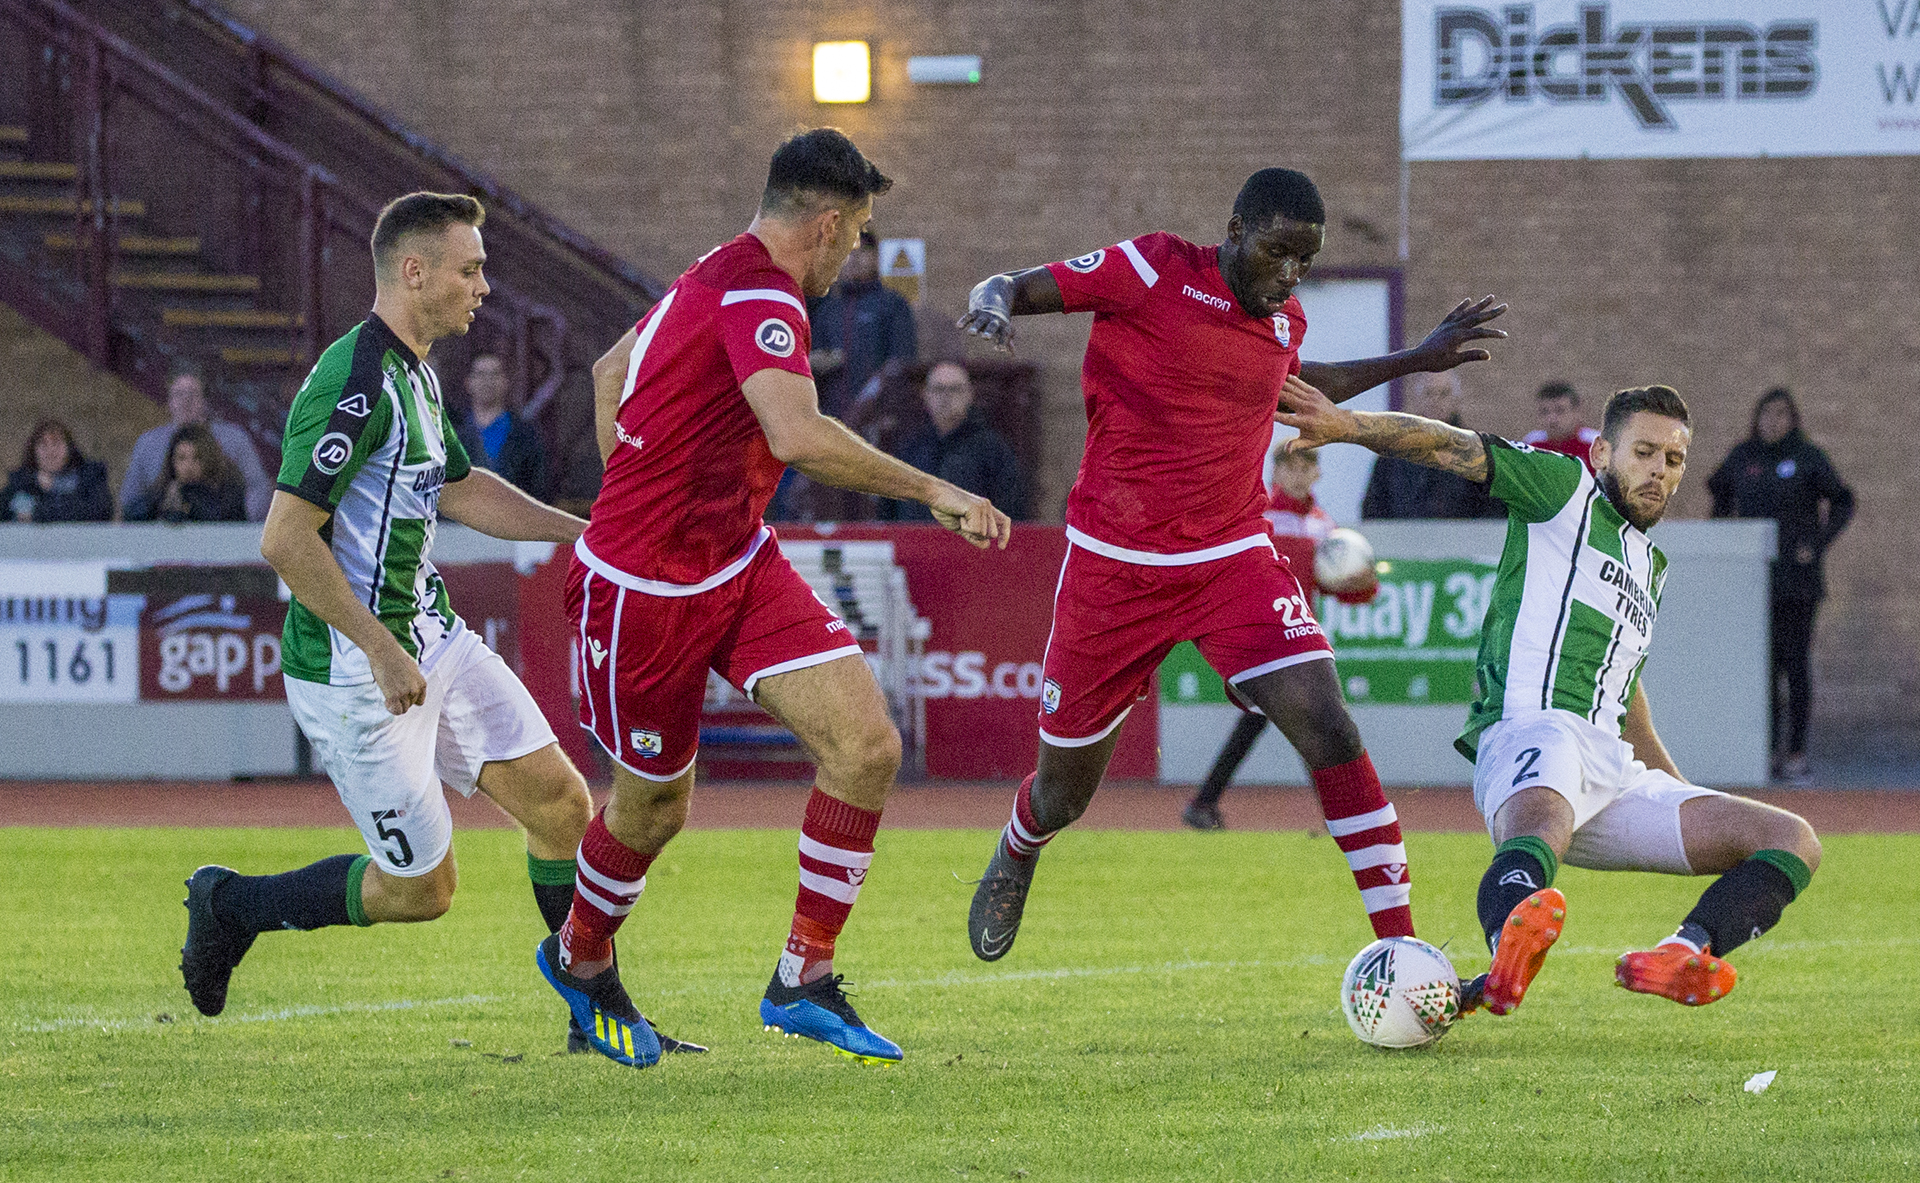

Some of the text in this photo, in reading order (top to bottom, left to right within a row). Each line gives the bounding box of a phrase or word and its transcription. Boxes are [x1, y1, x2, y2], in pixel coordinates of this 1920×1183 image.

[1182, 284, 1231, 312] macron
[764, 329, 789, 347] JD
[319, 444, 346, 463] JD
[1273, 595, 1317, 627] 22
[17, 639, 115, 684] 1161
[1512, 747, 1541, 787] 2
[371, 809, 413, 868] 5
